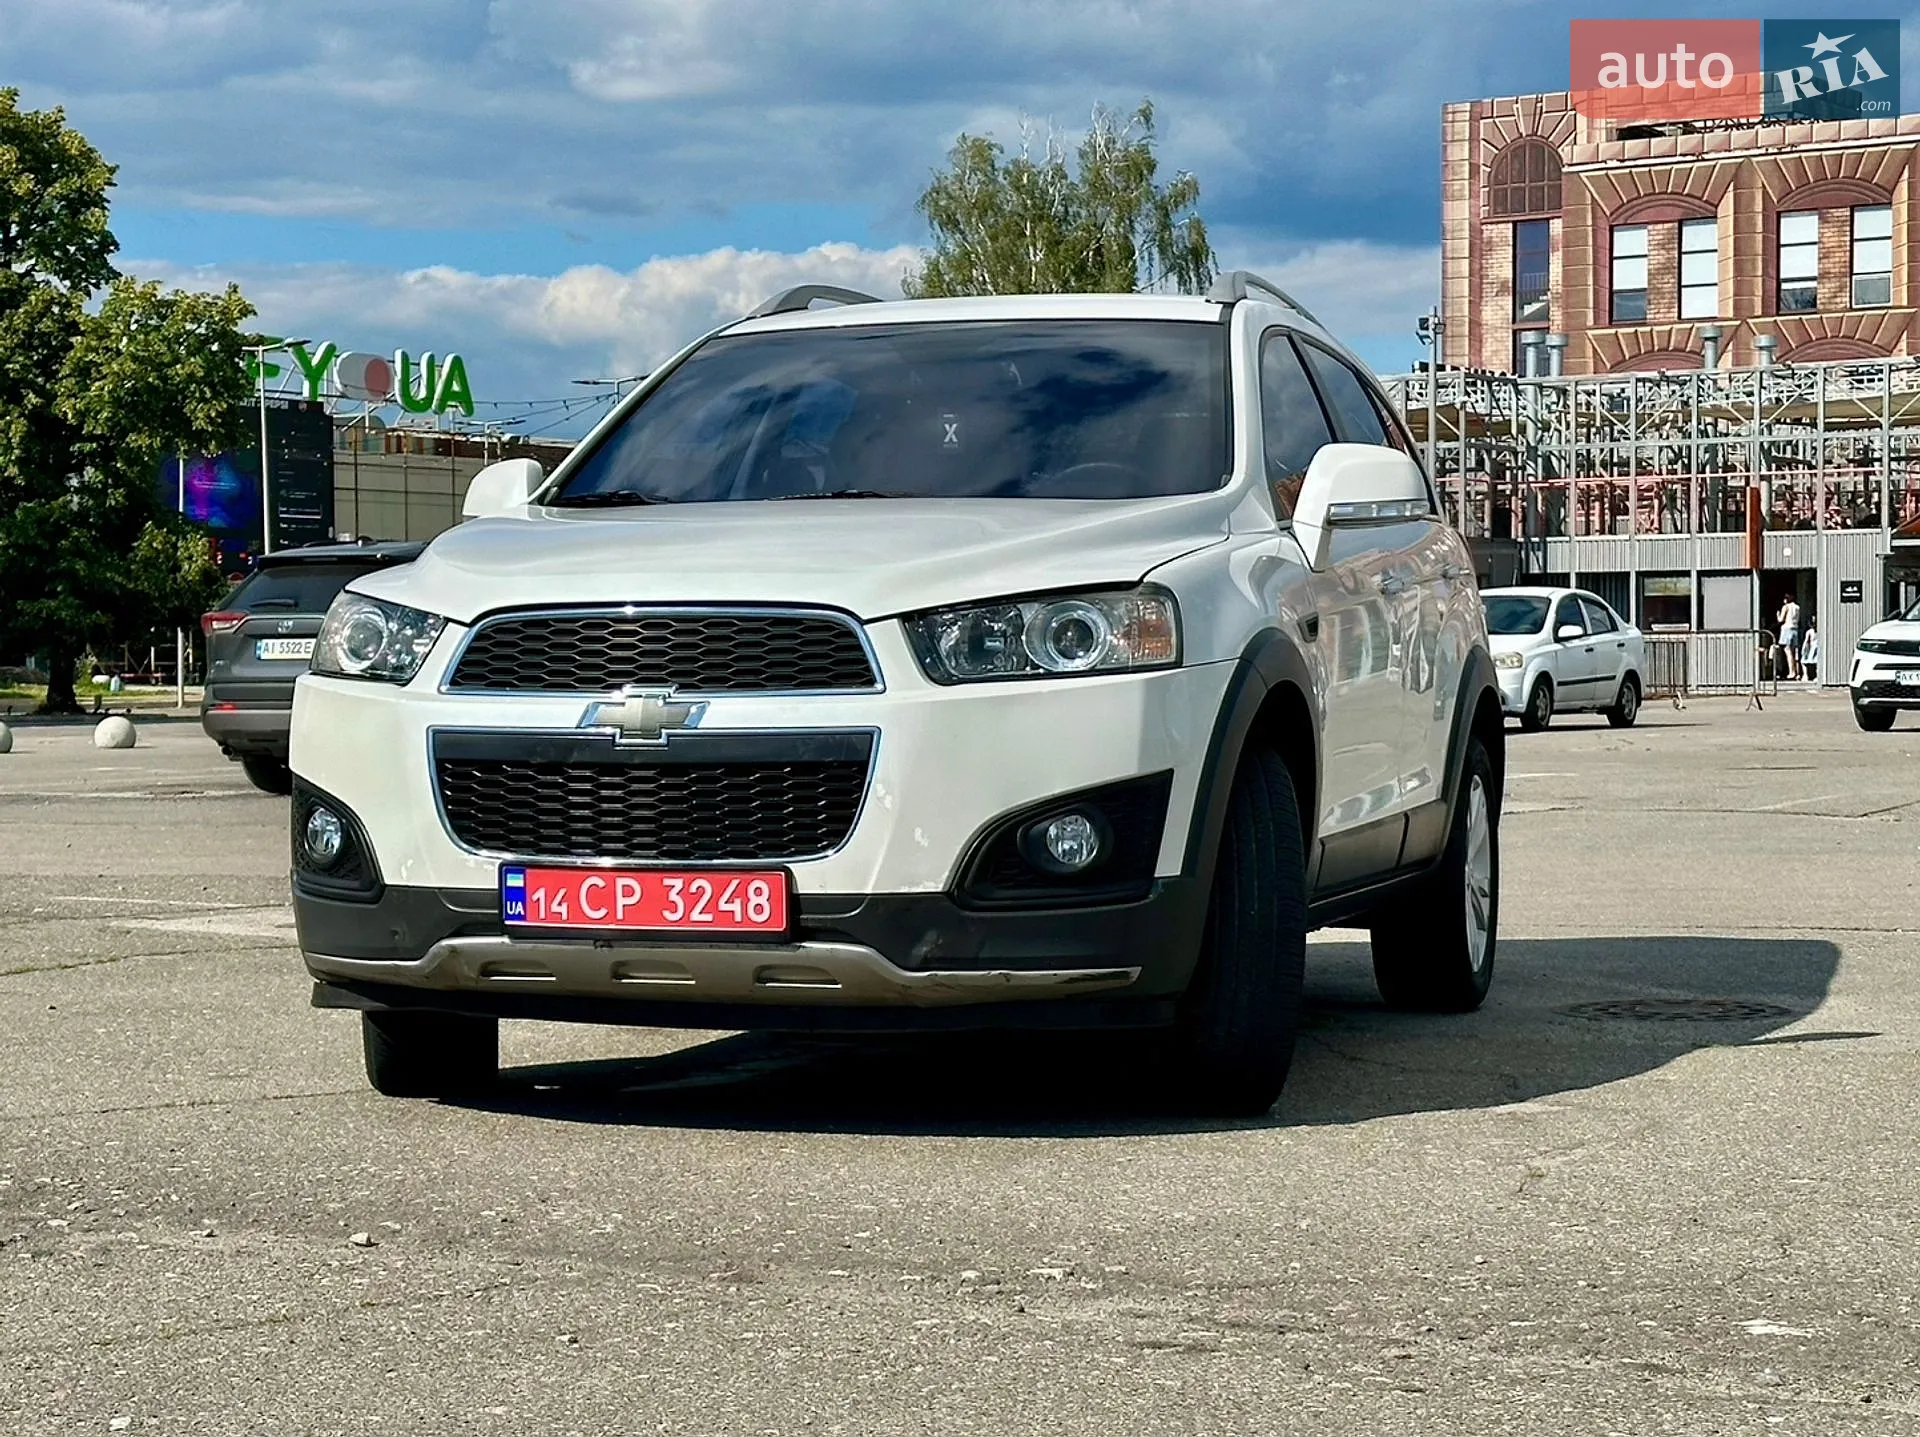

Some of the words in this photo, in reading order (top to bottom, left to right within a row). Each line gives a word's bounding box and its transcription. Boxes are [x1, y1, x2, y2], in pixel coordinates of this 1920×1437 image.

[279, 641, 302, 654] 5522
[507, 900, 525, 916] UA
[531, 886, 568, 921] 14
[578, 876, 642, 921] CP
[661, 877, 772, 924] 3248
